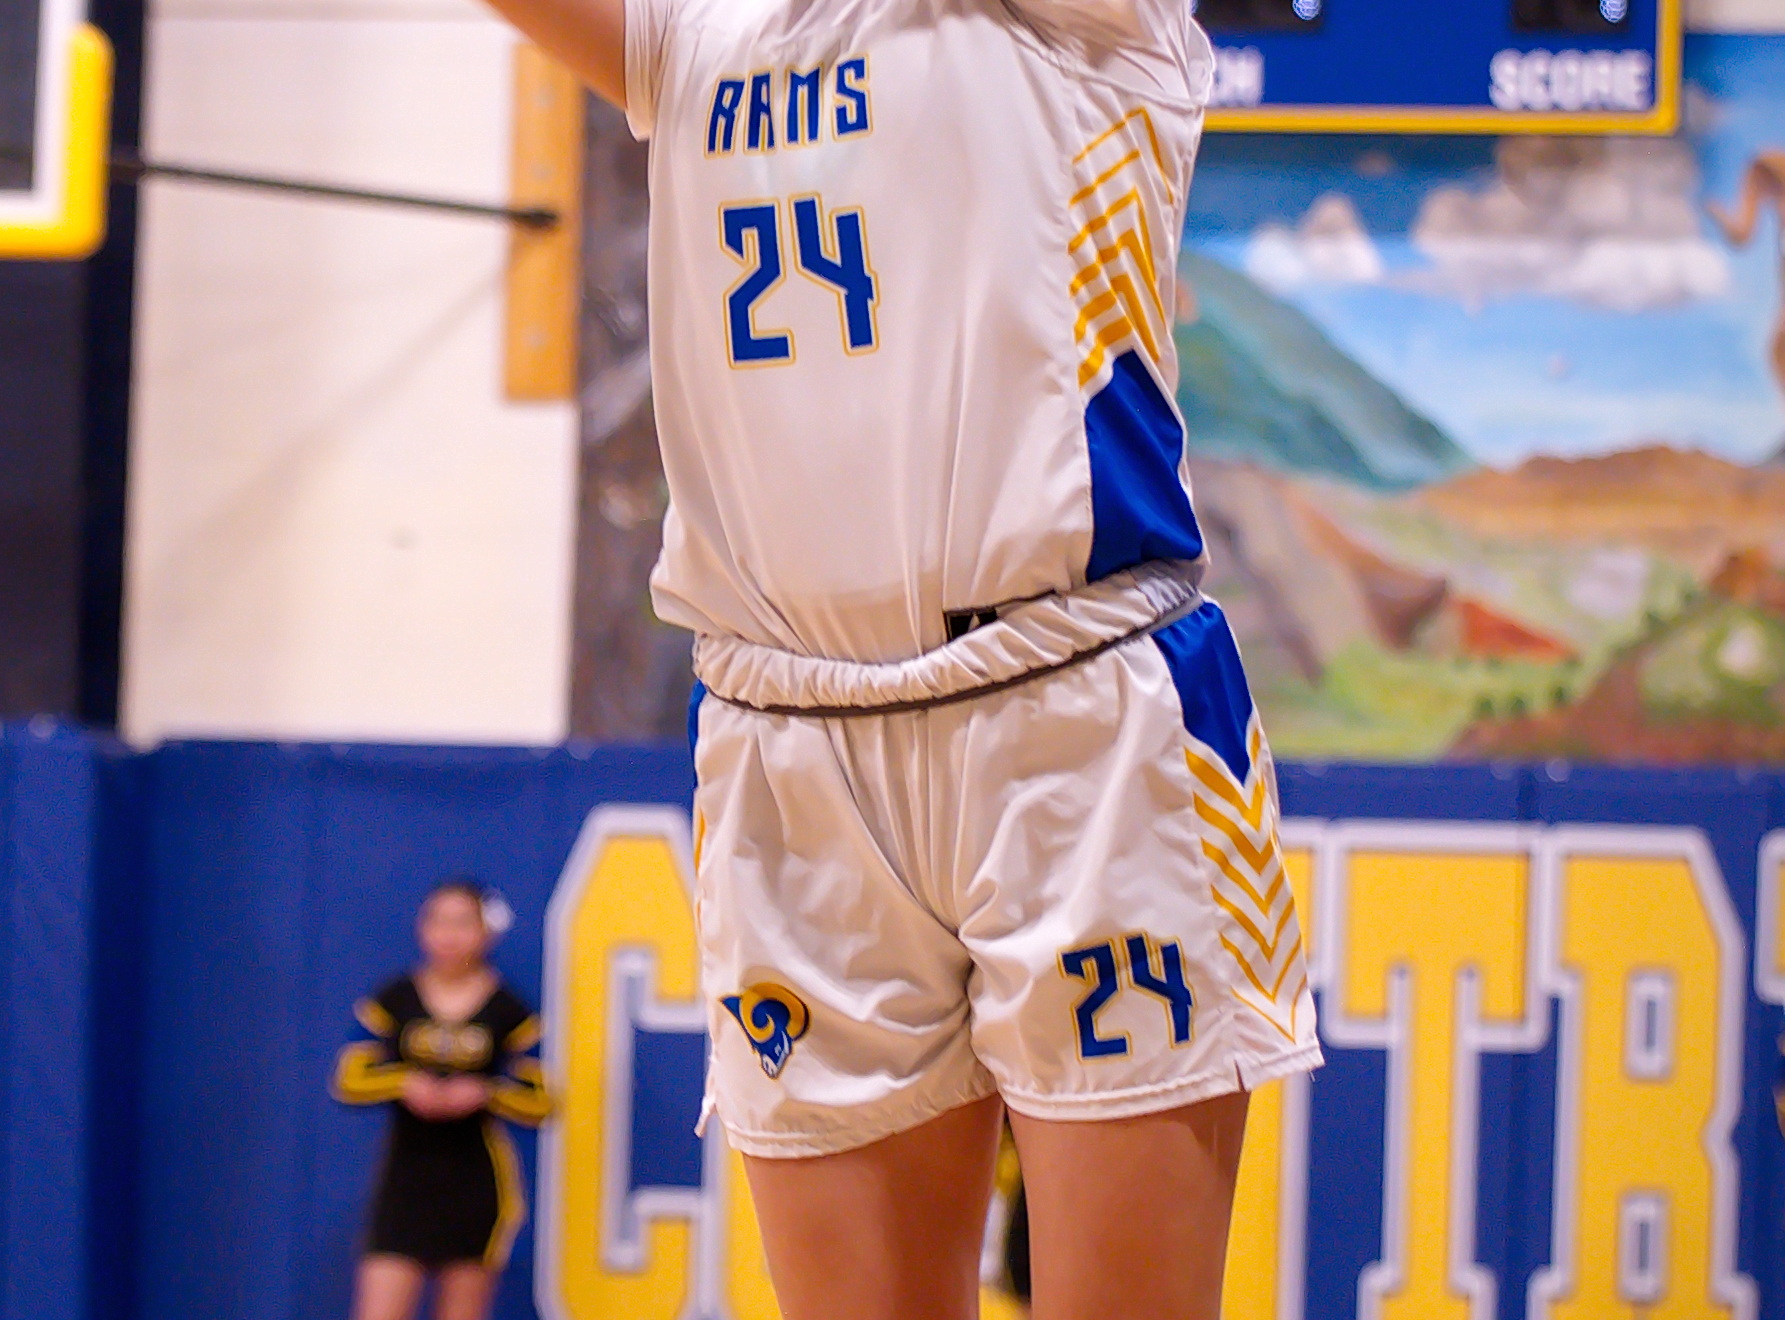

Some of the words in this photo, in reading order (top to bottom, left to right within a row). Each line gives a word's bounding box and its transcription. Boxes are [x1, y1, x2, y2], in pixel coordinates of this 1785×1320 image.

[704, 54, 872, 159] RAMS
[1489, 47, 1653, 111] SCORE
[718, 192, 879, 370] 24
[1057, 930, 1197, 1066] 24
